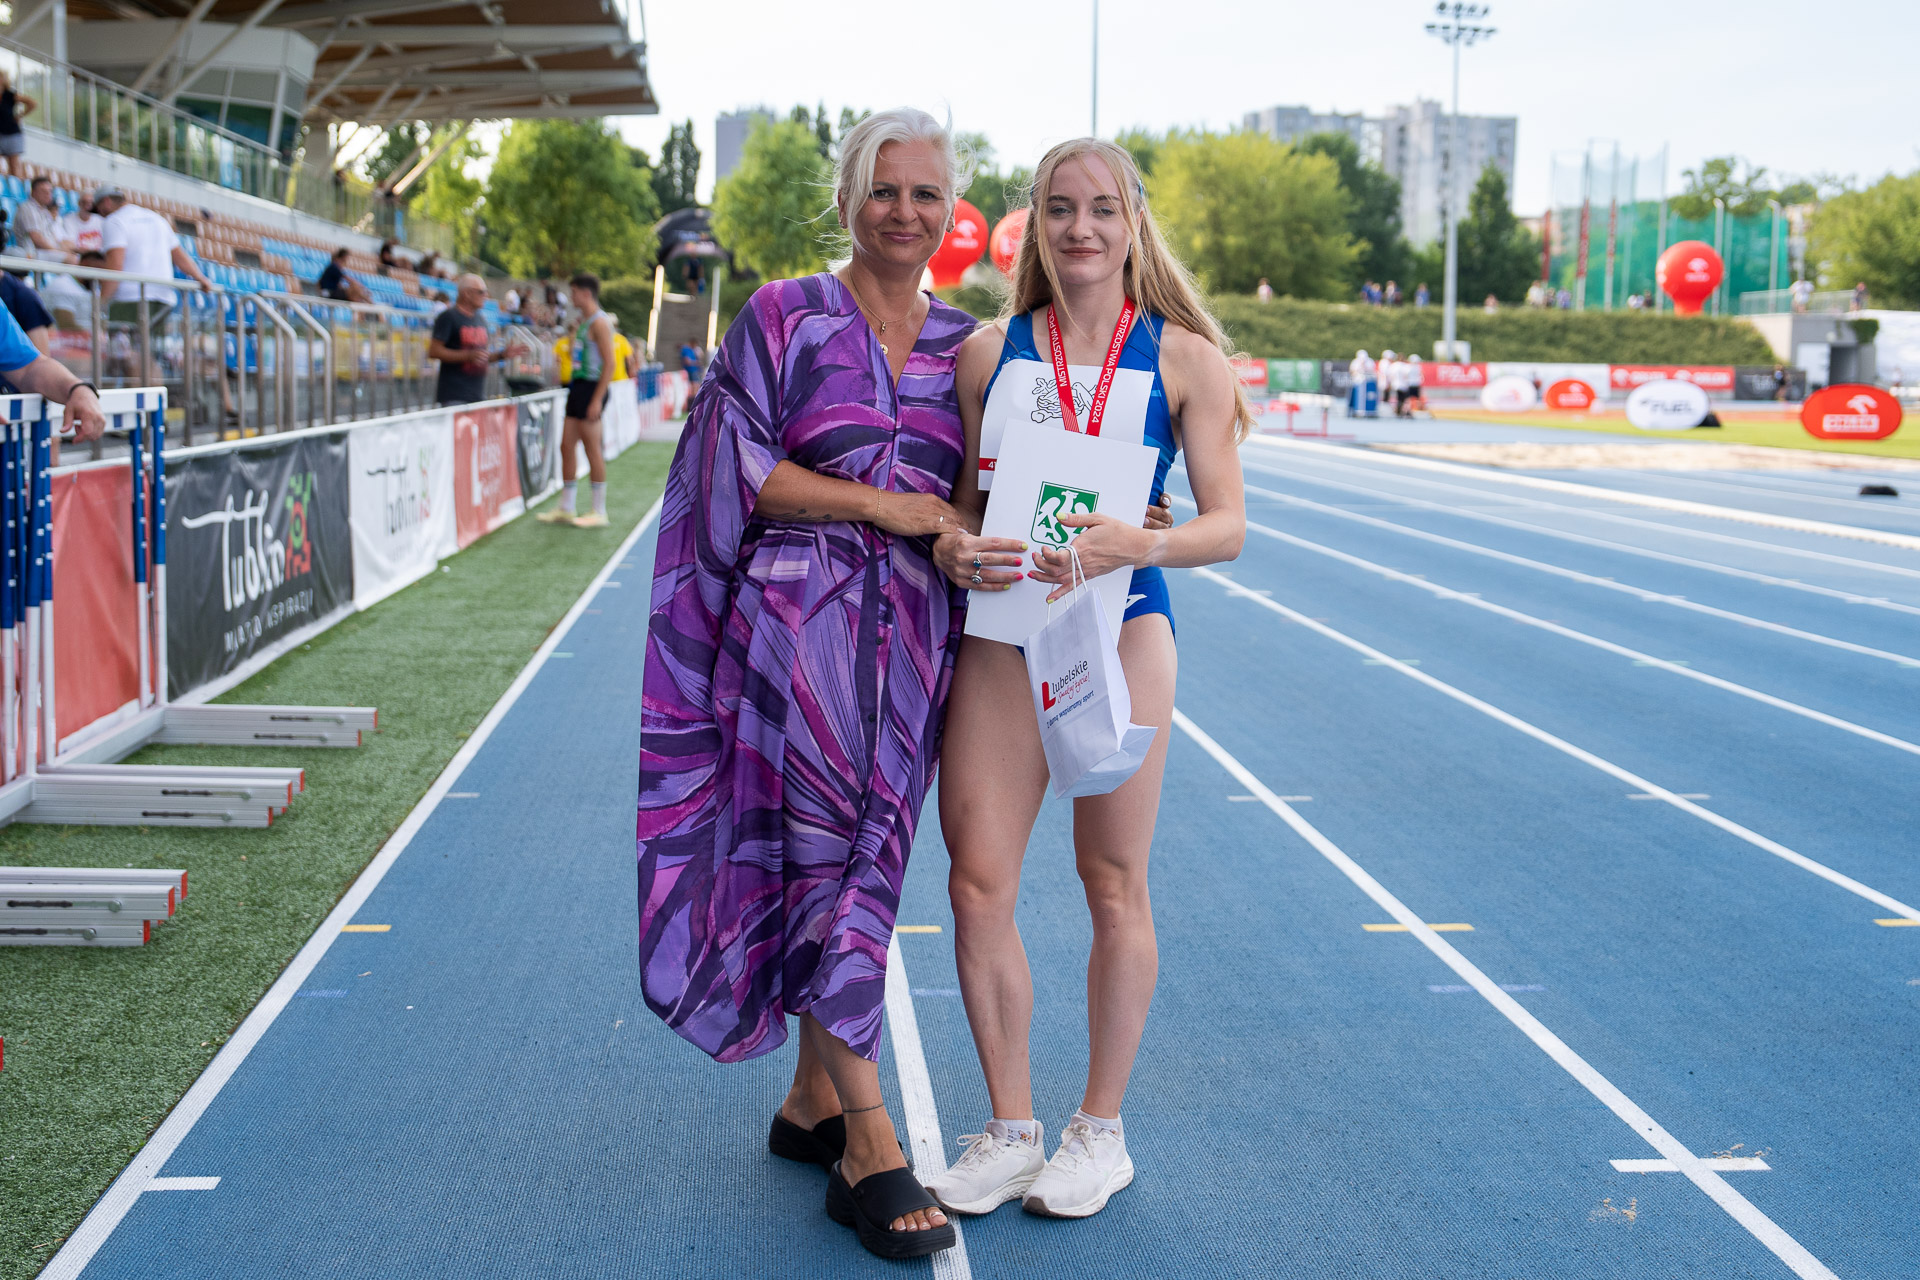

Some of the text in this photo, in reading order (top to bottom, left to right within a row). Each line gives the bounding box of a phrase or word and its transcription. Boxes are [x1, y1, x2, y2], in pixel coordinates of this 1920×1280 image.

[1051, 328, 1067, 387] MISTRZOSTWA
[1091, 308, 1132, 423] MISTRZOSTWA POLSKI 2024
[1083, 690, 1095, 703] sport
